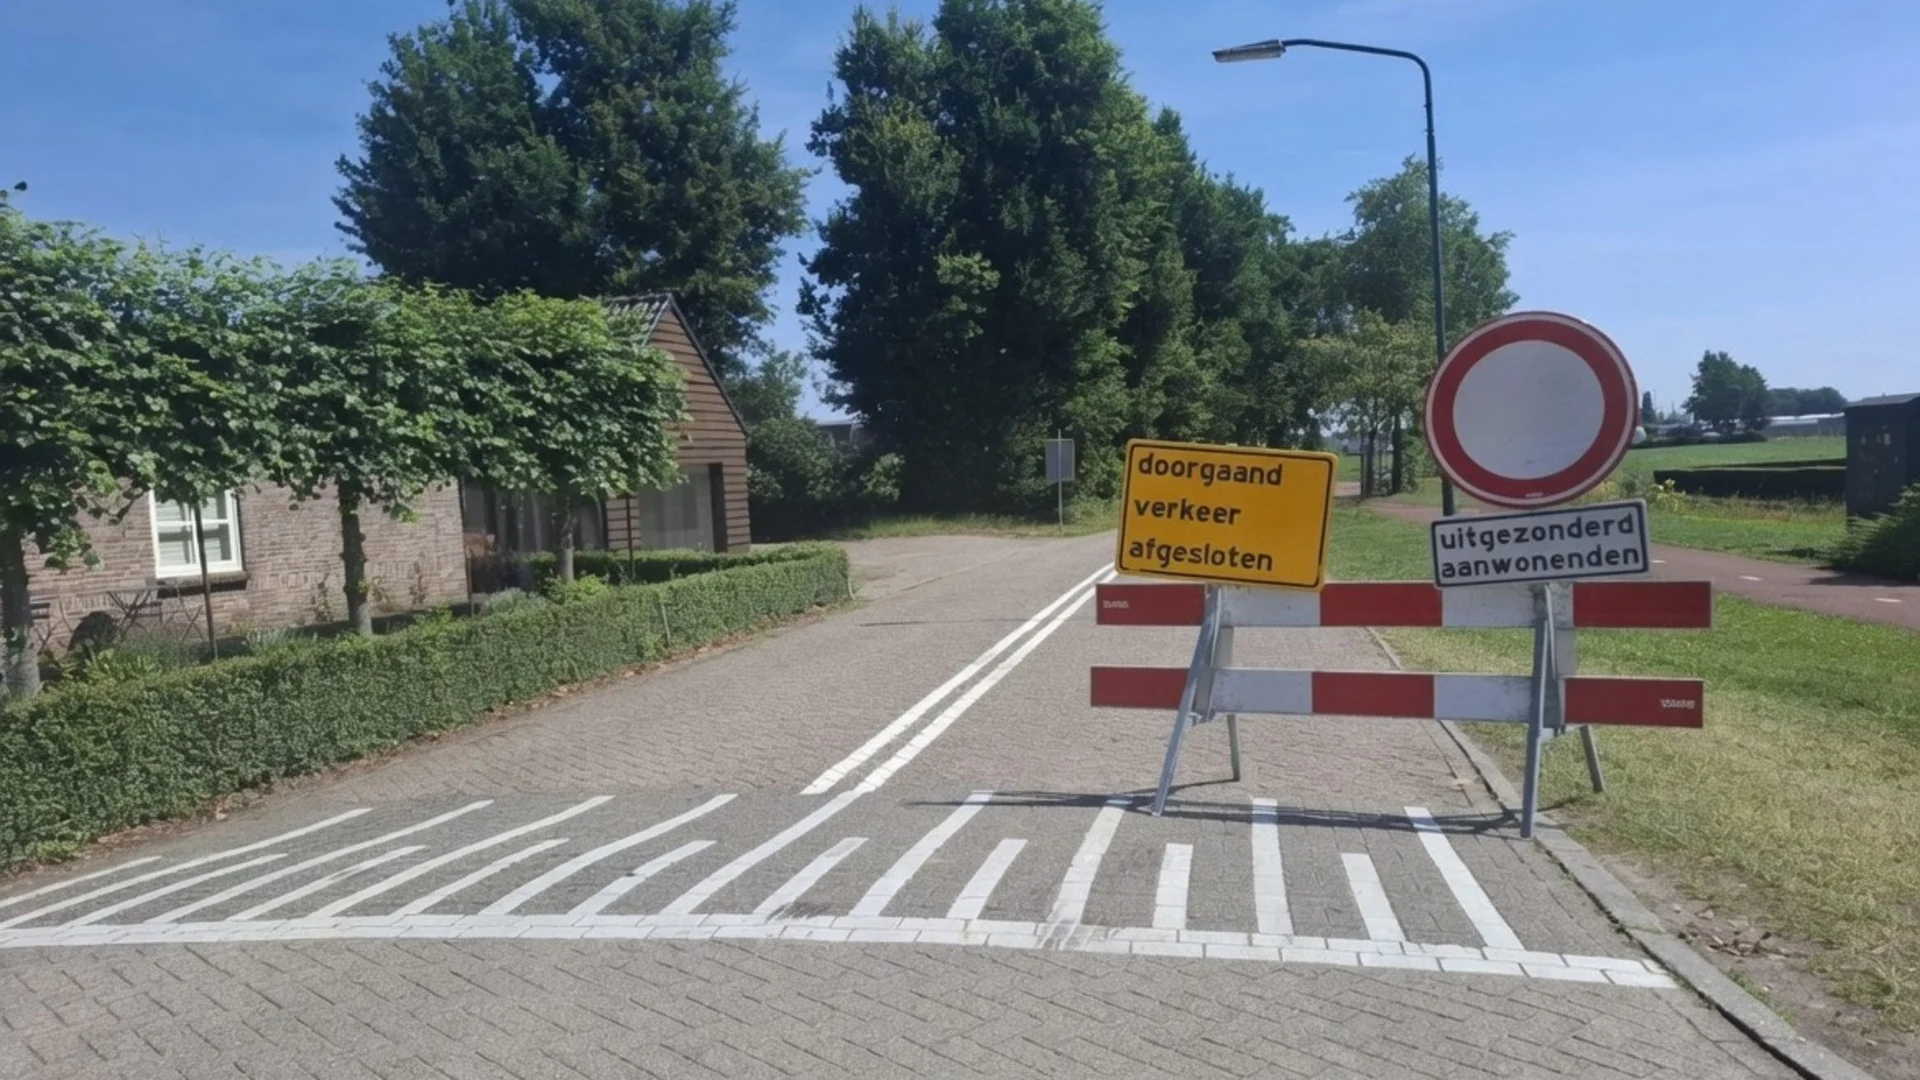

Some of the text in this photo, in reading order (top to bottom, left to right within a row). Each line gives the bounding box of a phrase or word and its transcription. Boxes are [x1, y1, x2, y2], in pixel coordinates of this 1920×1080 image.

[1138, 452, 1283, 487] doorgaand
[1134, 498, 1241, 525] verkeer
[1440, 512, 1634, 552] uitgezonderd
[1129, 538, 1273, 571] afgesloten
[1441, 545, 1640, 578] aanwonenden
